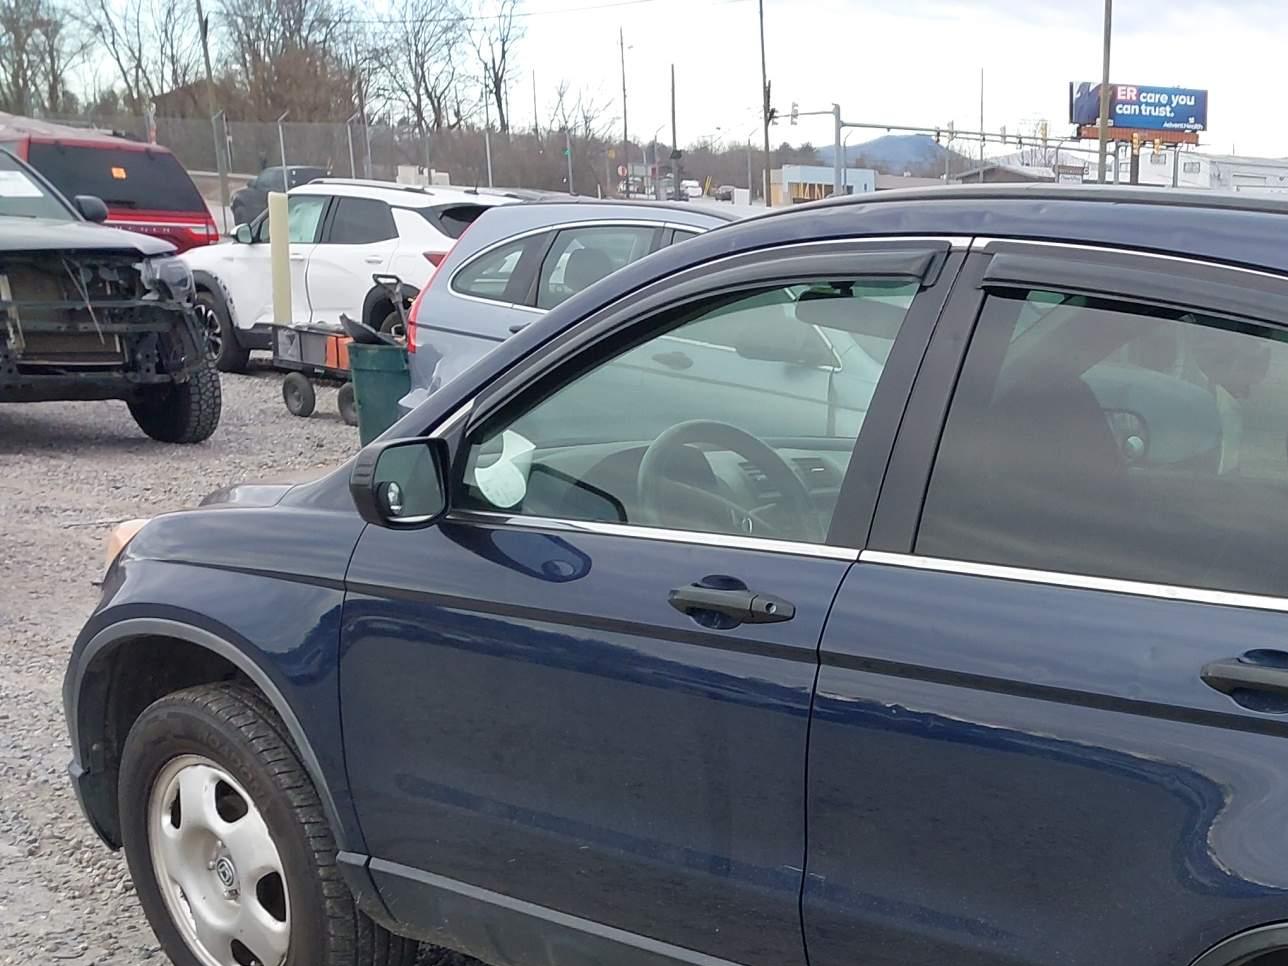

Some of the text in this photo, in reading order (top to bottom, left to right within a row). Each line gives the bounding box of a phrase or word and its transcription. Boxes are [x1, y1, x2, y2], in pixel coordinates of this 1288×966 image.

[1117, 86, 1195, 107] ER care you
[1116, 104, 1175, 117] can trust.
